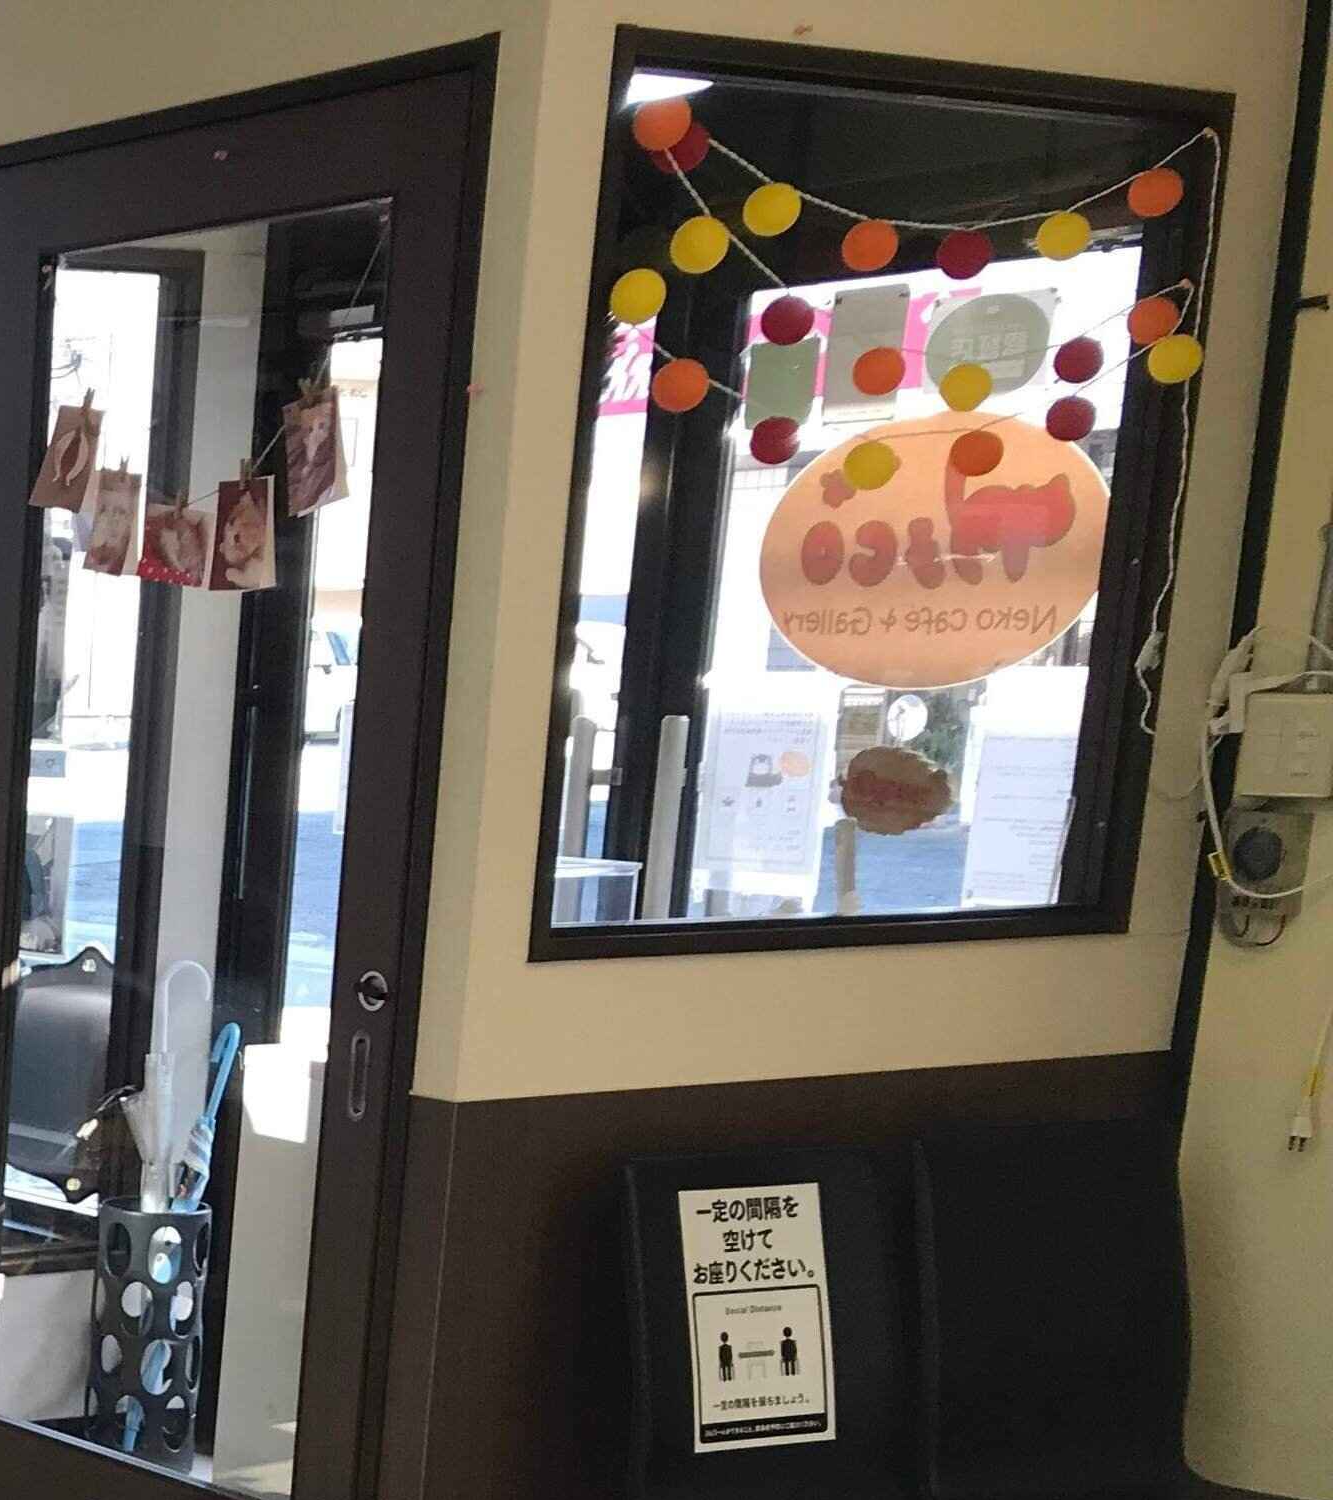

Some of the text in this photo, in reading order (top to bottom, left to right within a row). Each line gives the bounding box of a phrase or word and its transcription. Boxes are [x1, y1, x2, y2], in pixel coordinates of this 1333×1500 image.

[695, 1195, 799, 1223] 一定の間隔を
[723, 1228, 773, 1252] 空けて
[693, 1257, 815, 1285] お座りください。
